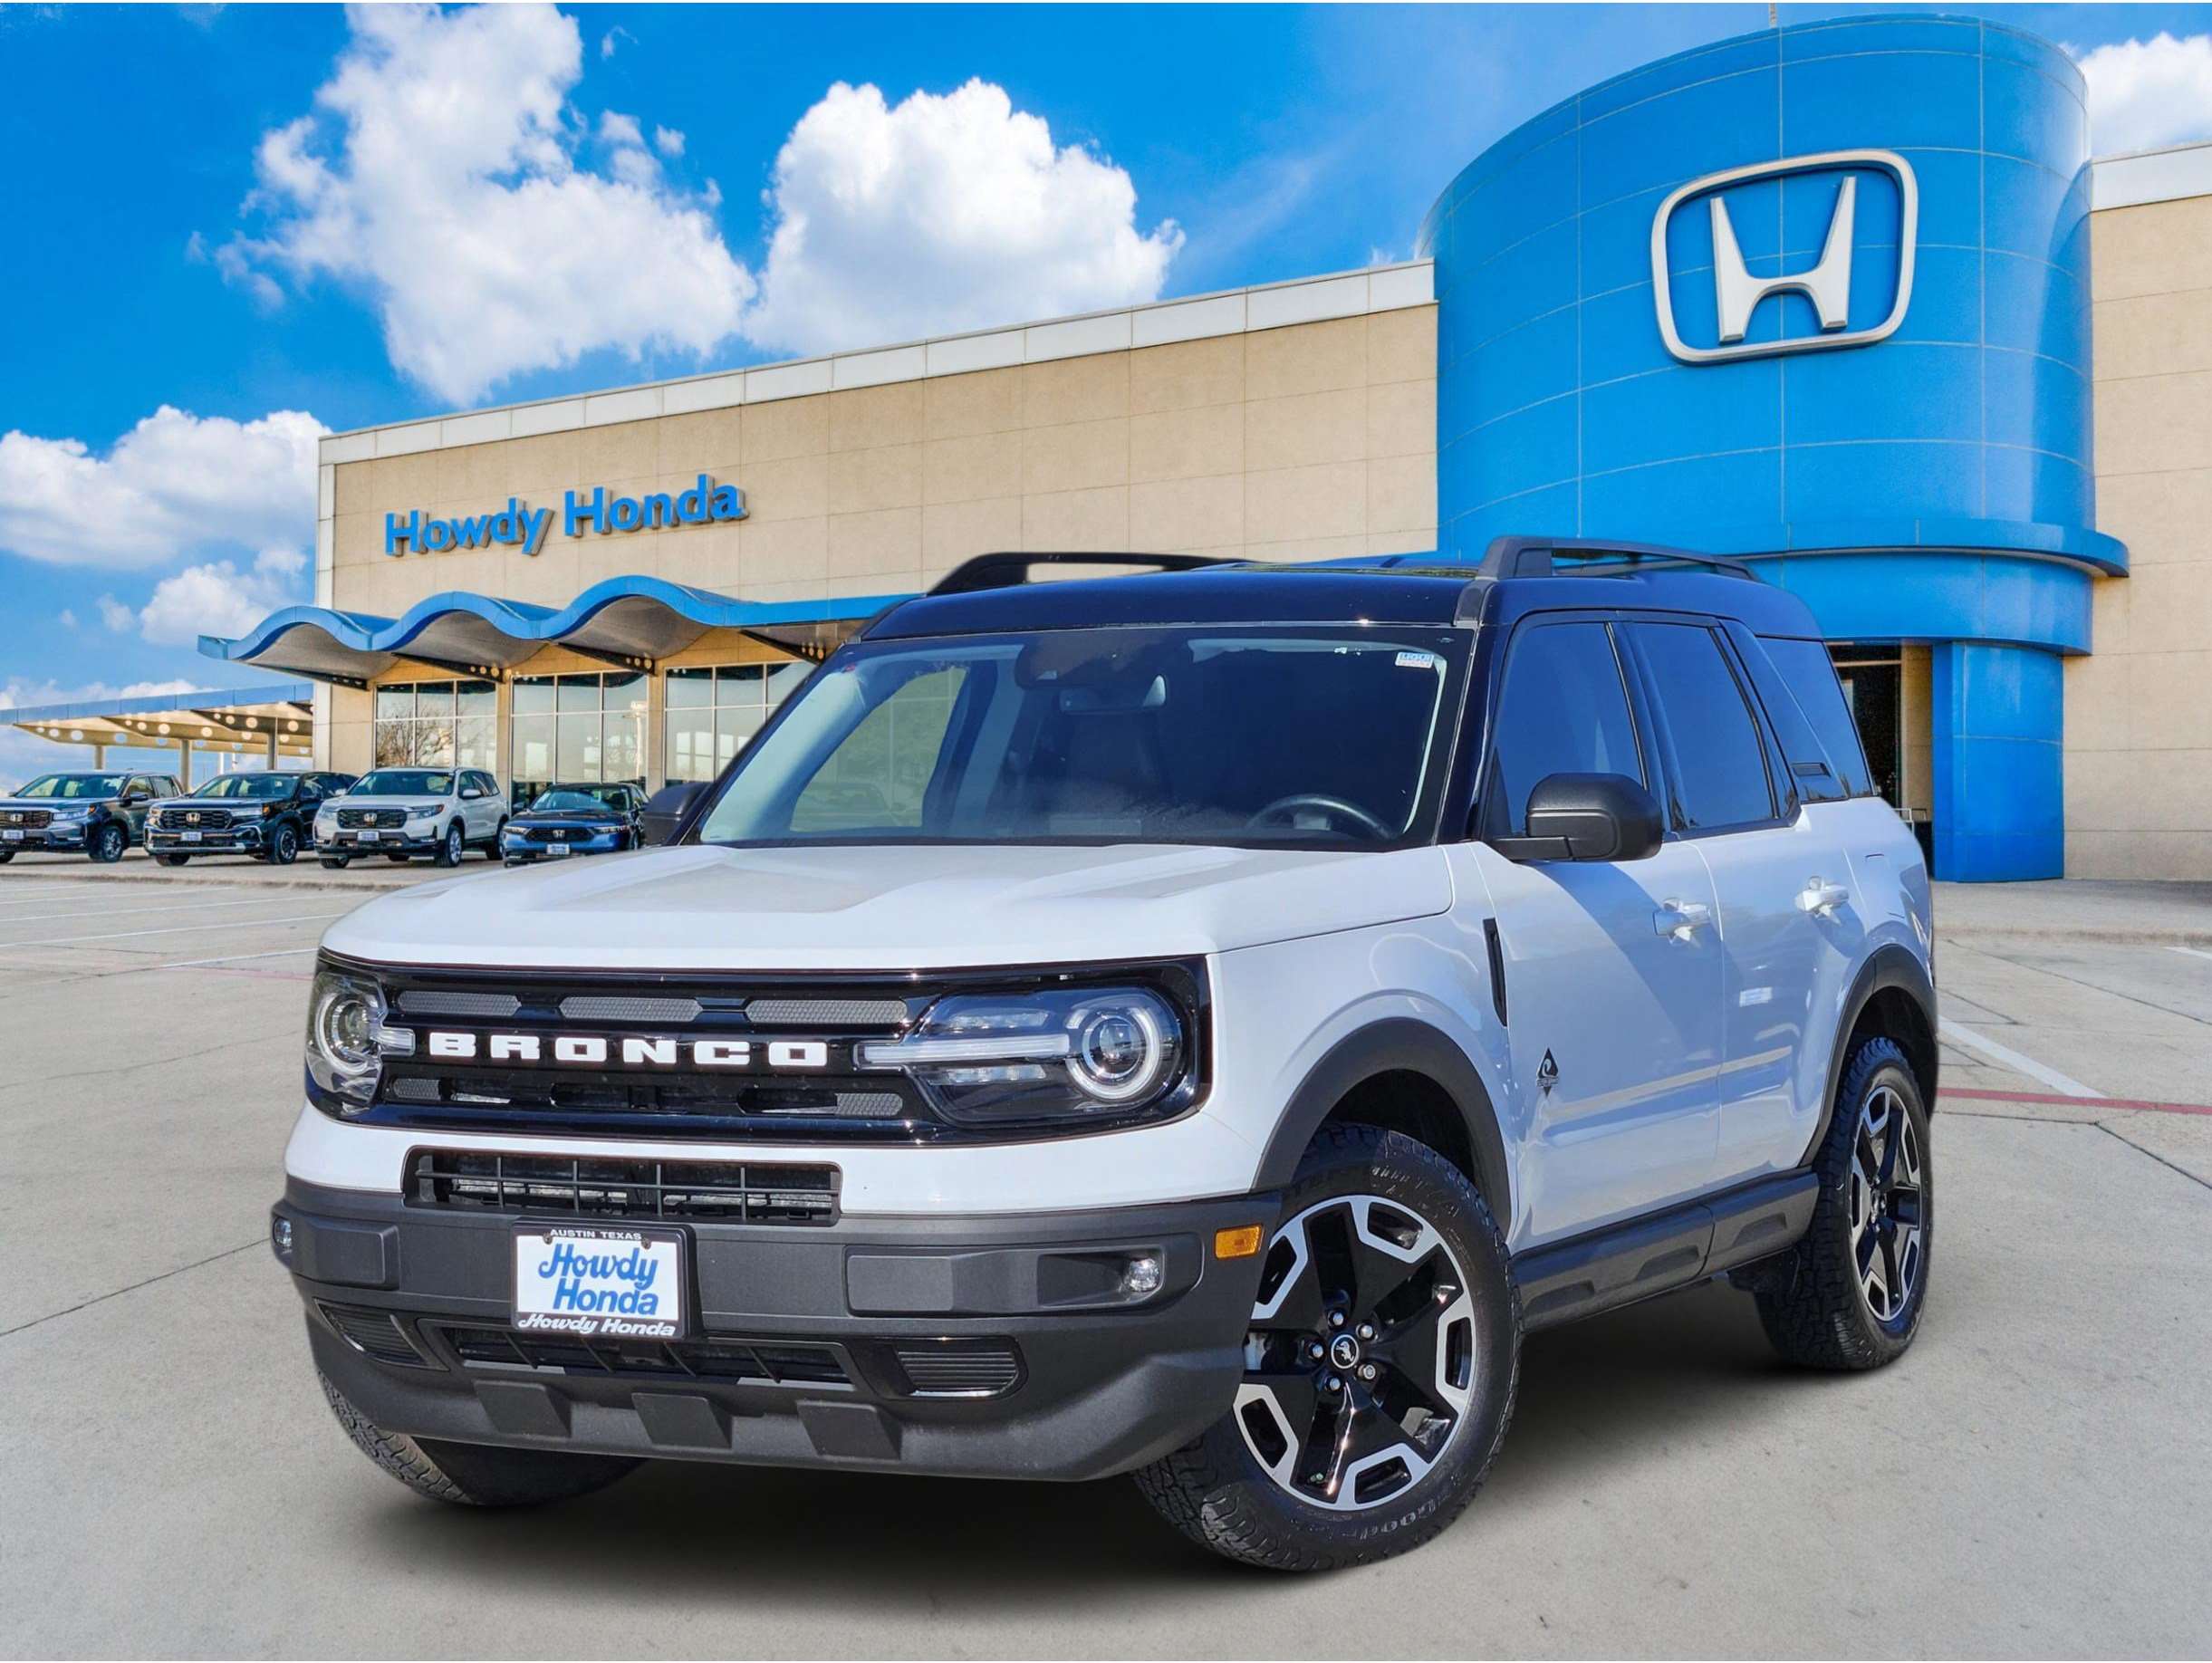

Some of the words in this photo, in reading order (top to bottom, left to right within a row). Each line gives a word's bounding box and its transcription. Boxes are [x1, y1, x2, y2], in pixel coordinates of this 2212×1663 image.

[385, 497, 554, 557] Howdy
[564, 474, 749, 539] Honda
[428, 1032, 828, 1067] BRONCO
[550, 1228, 596, 1238] AUSTIN
[600, 1231, 642, 1240] TEXAS
[538, 1243, 659, 1290] Howdy
[553, 1277, 659, 1315] Honda
[518, 1313, 598, 1334] Howdy
[601, 1319, 676, 1336] Honda
